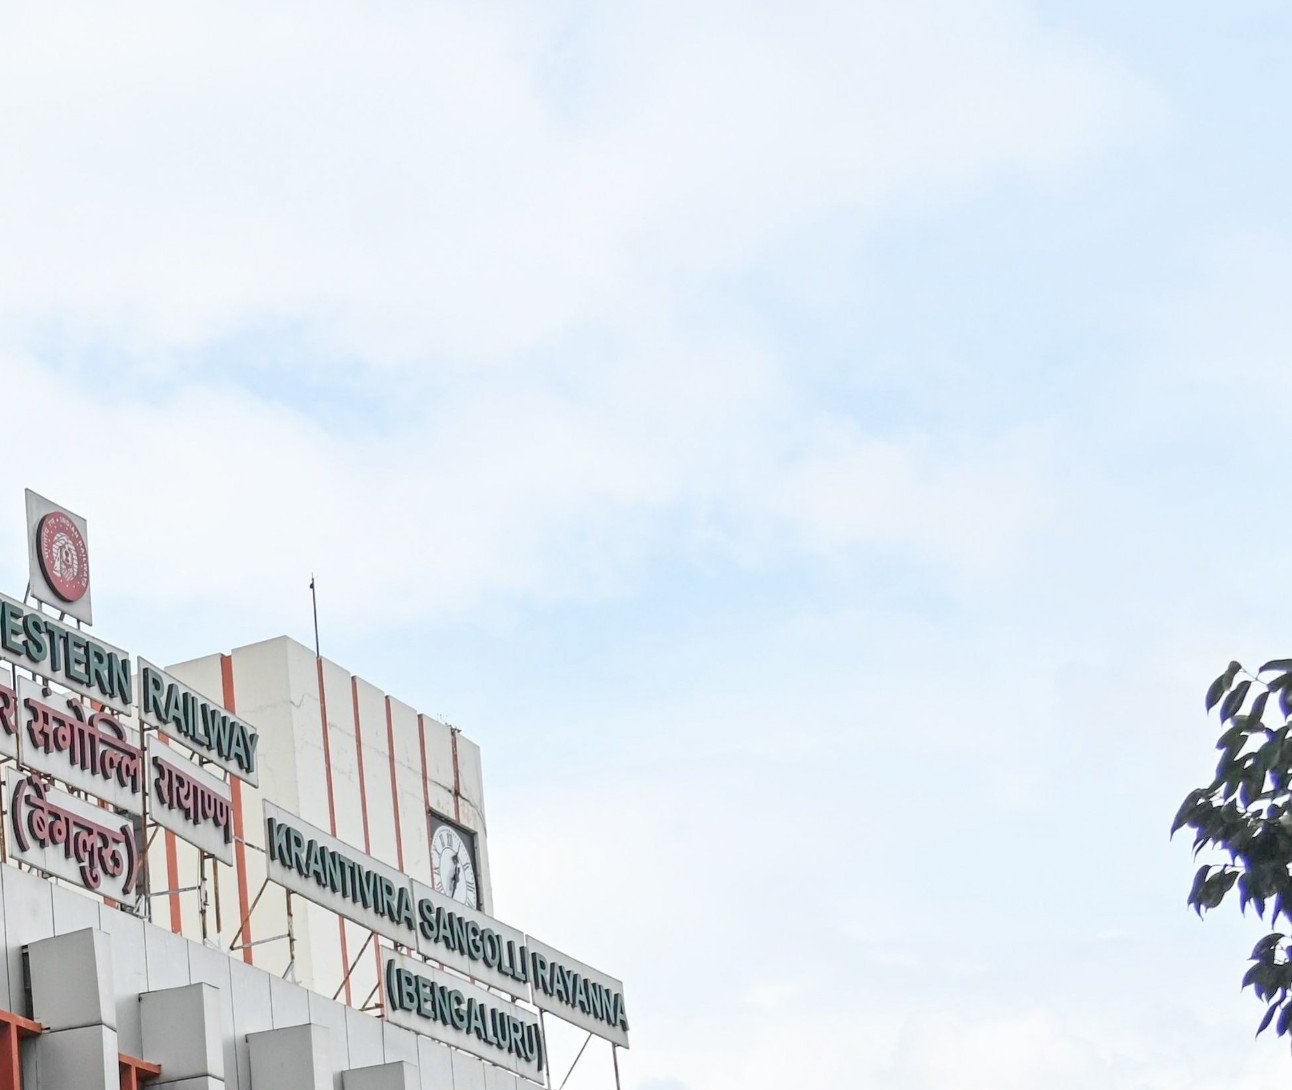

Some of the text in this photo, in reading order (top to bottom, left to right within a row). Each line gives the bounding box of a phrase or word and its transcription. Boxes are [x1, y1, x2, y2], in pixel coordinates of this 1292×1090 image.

[23, 682, 143, 793] संगोल्लि
[142, 666, 259, 774] RAILWAY
[267, 817, 630, 1032] KRANTIVIRA SANGOLLI RAYANNA
[385, 957, 544, 1072] (BENGALURU)
